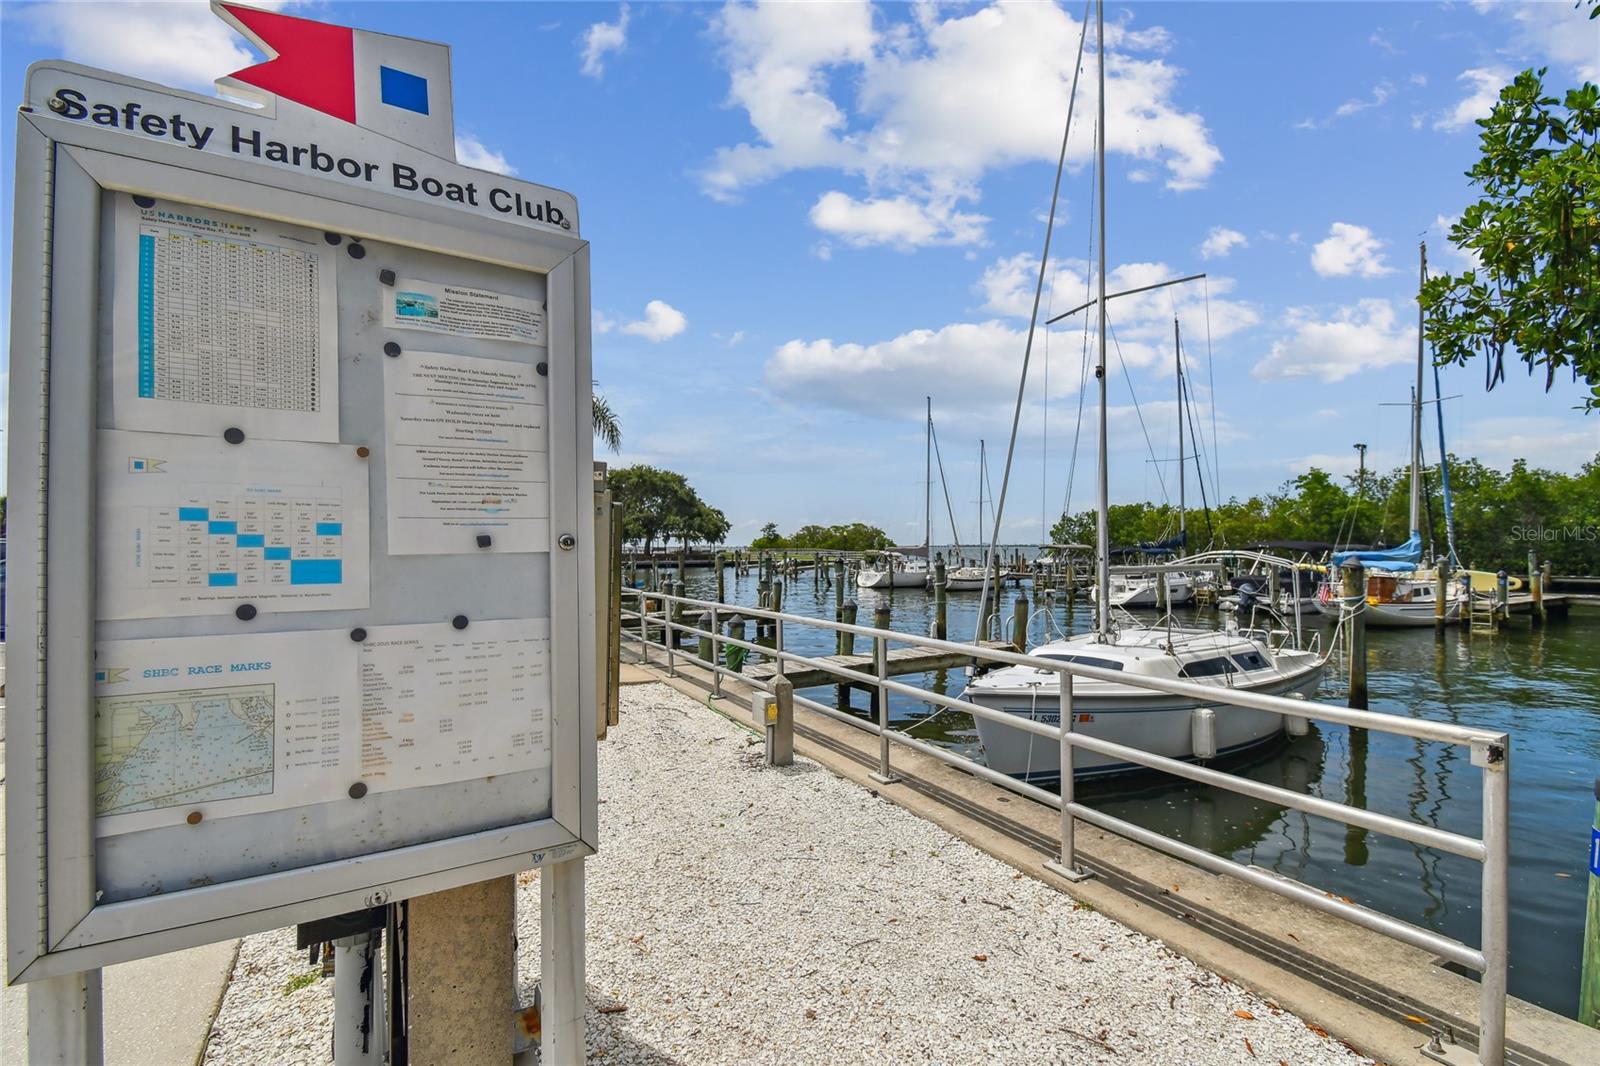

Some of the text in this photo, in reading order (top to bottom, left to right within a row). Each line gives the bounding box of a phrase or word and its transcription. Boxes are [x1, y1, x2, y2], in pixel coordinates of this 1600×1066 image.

[54, 88, 564, 226] Safety Harbor Boat Club
[158, 211, 218, 227] HARBORS
[444, 288, 499, 300] Mission Statement
[188, 665, 223, 676] RACE
[230, 662, 272, 673] MARKS
